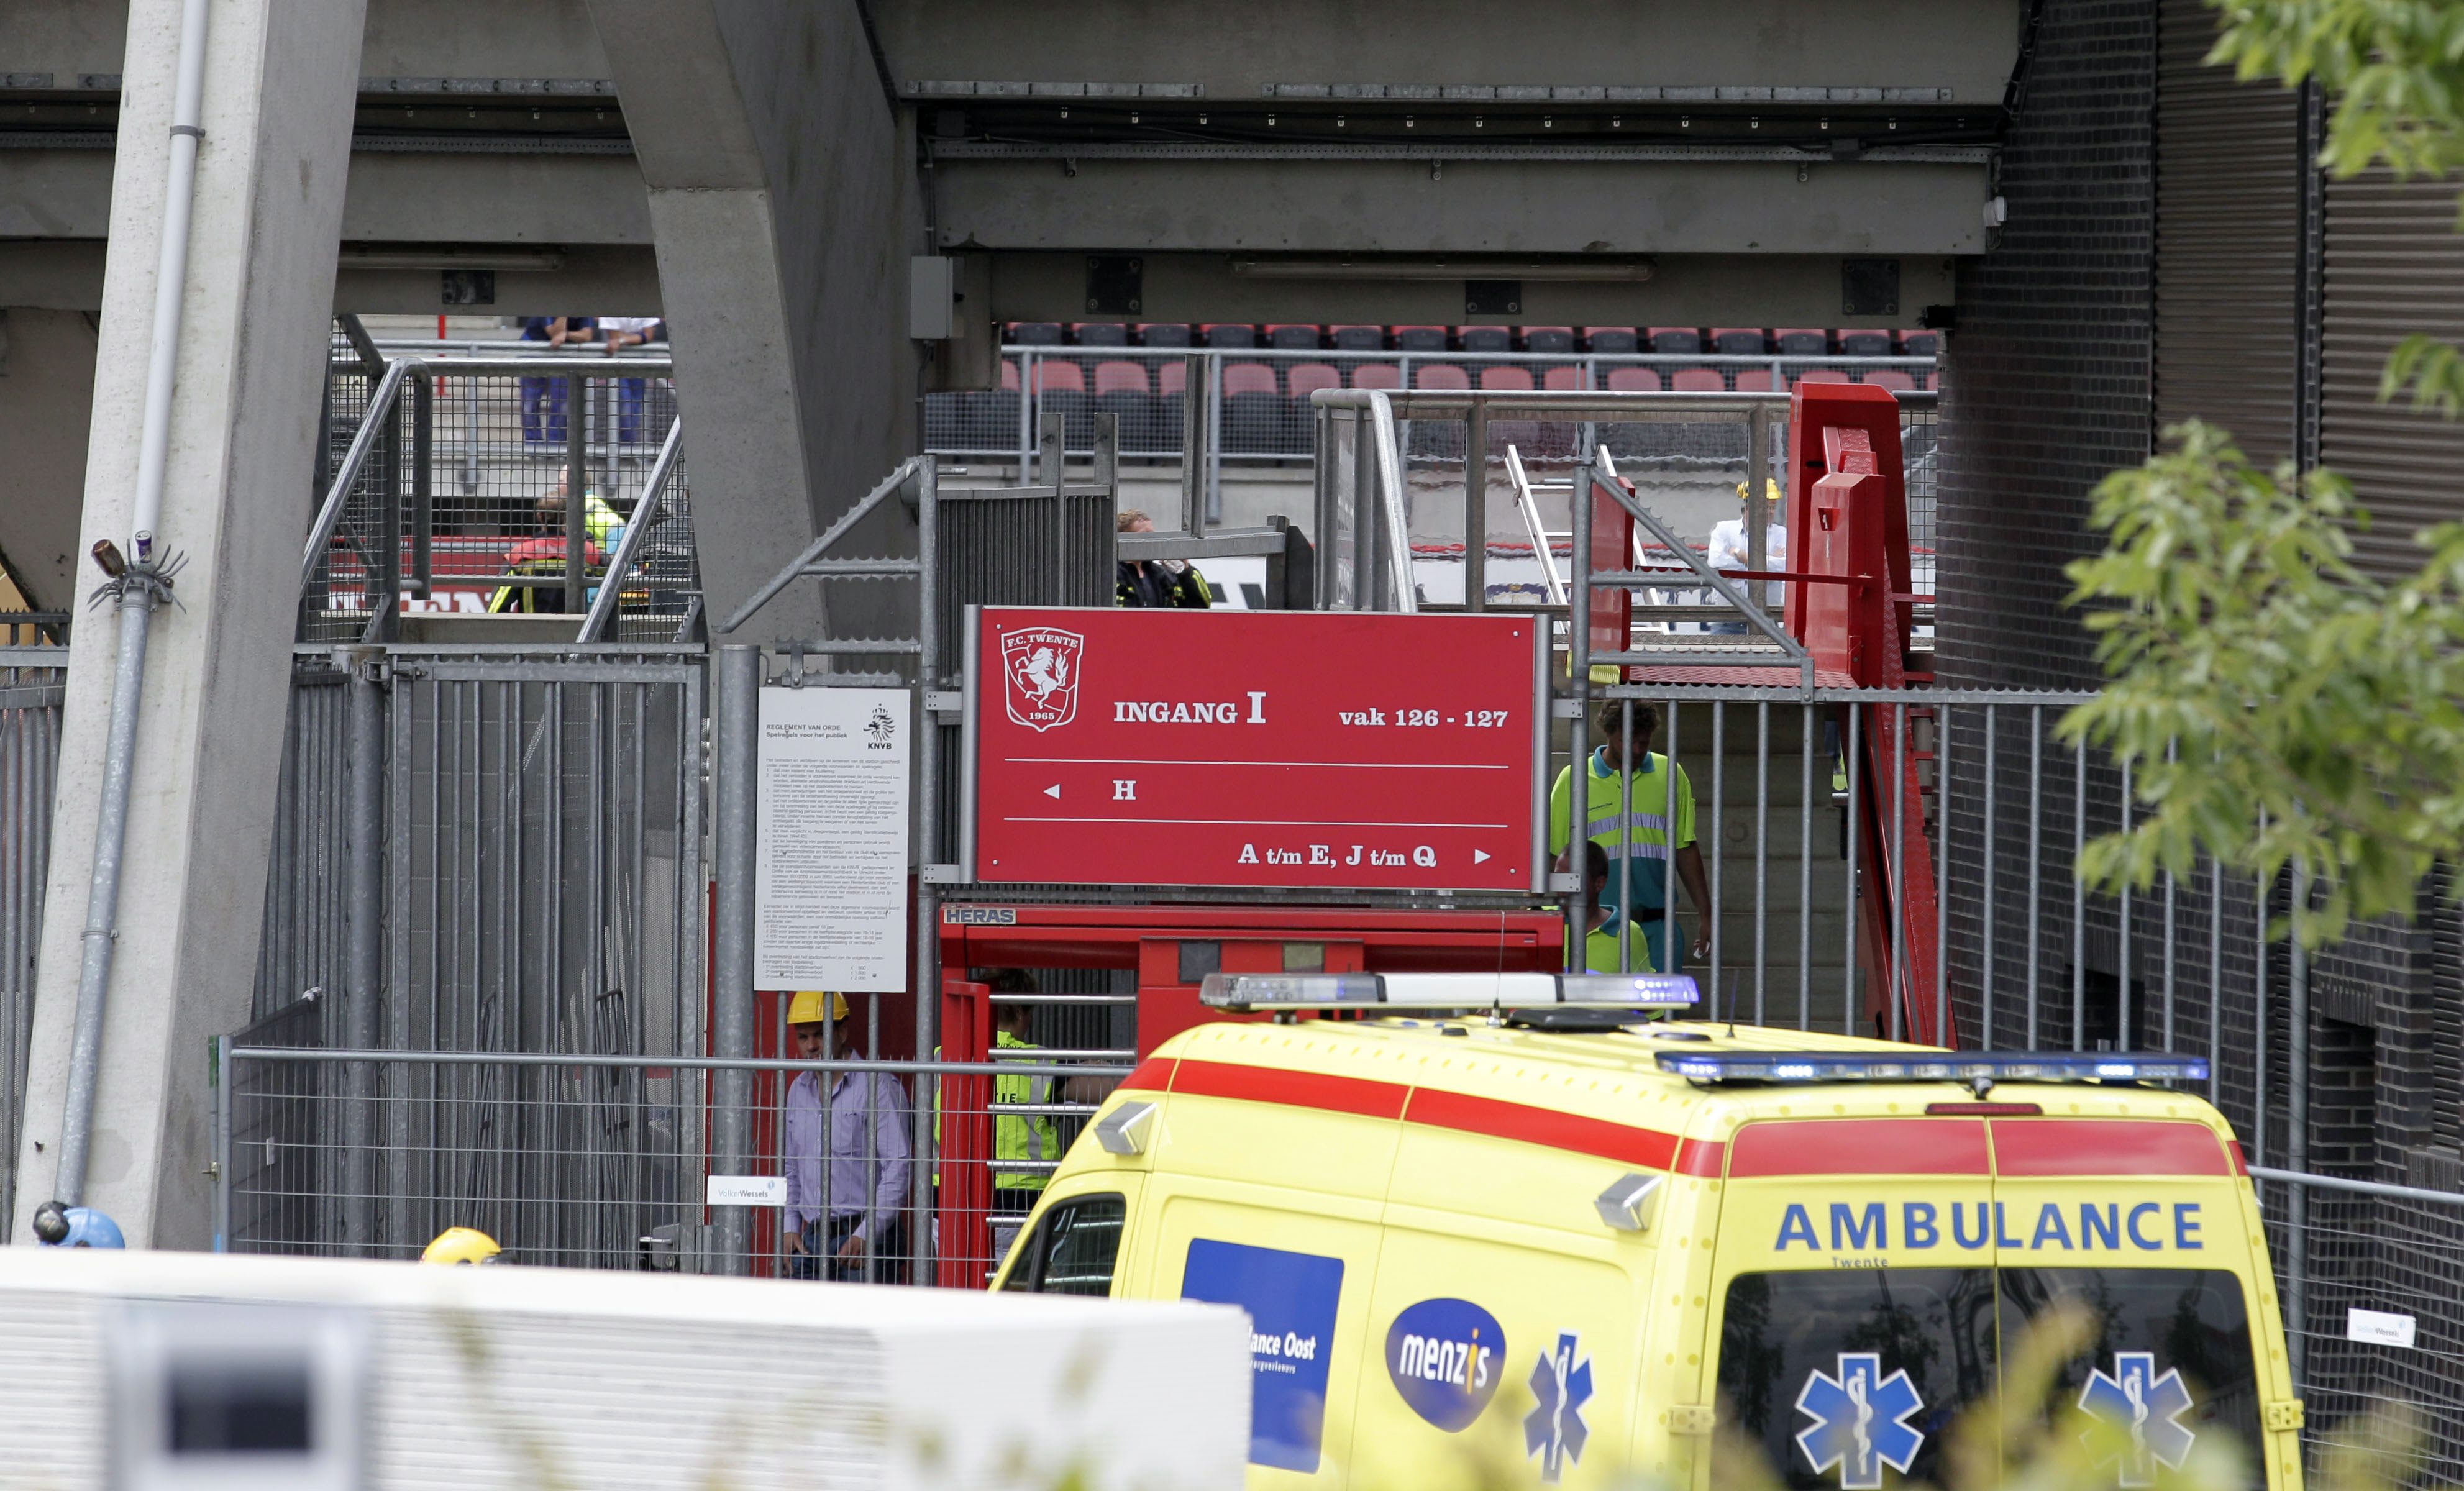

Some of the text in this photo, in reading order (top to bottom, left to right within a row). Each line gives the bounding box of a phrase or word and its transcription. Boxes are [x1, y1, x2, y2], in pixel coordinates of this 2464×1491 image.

[1006, 634, 1079, 649] F.C. TWENTE
[1029, 712, 1055, 720] 1965
[1113, 691, 1267, 724] INGANG I
[1339, 707, 1387, 726] vak
[1395, 709, 1440, 727] 126
[1464, 710, 1509, 728] 127
[1111, 779, 1137, 801] H
[1236, 842, 1438, 869] A t/m E, J t/m Q
[946, 909, 1014, 923] HERAS
[718, 1189, 768, 1198] VolkerWessels
[1775, 1201, 2204, 1251] AMBULANCE
[1832, 1256, 1888, 1268] Twente
[1284, 1331, 1317, 1361] Oost
[1399, 1327, 1491, 1395] menzis
